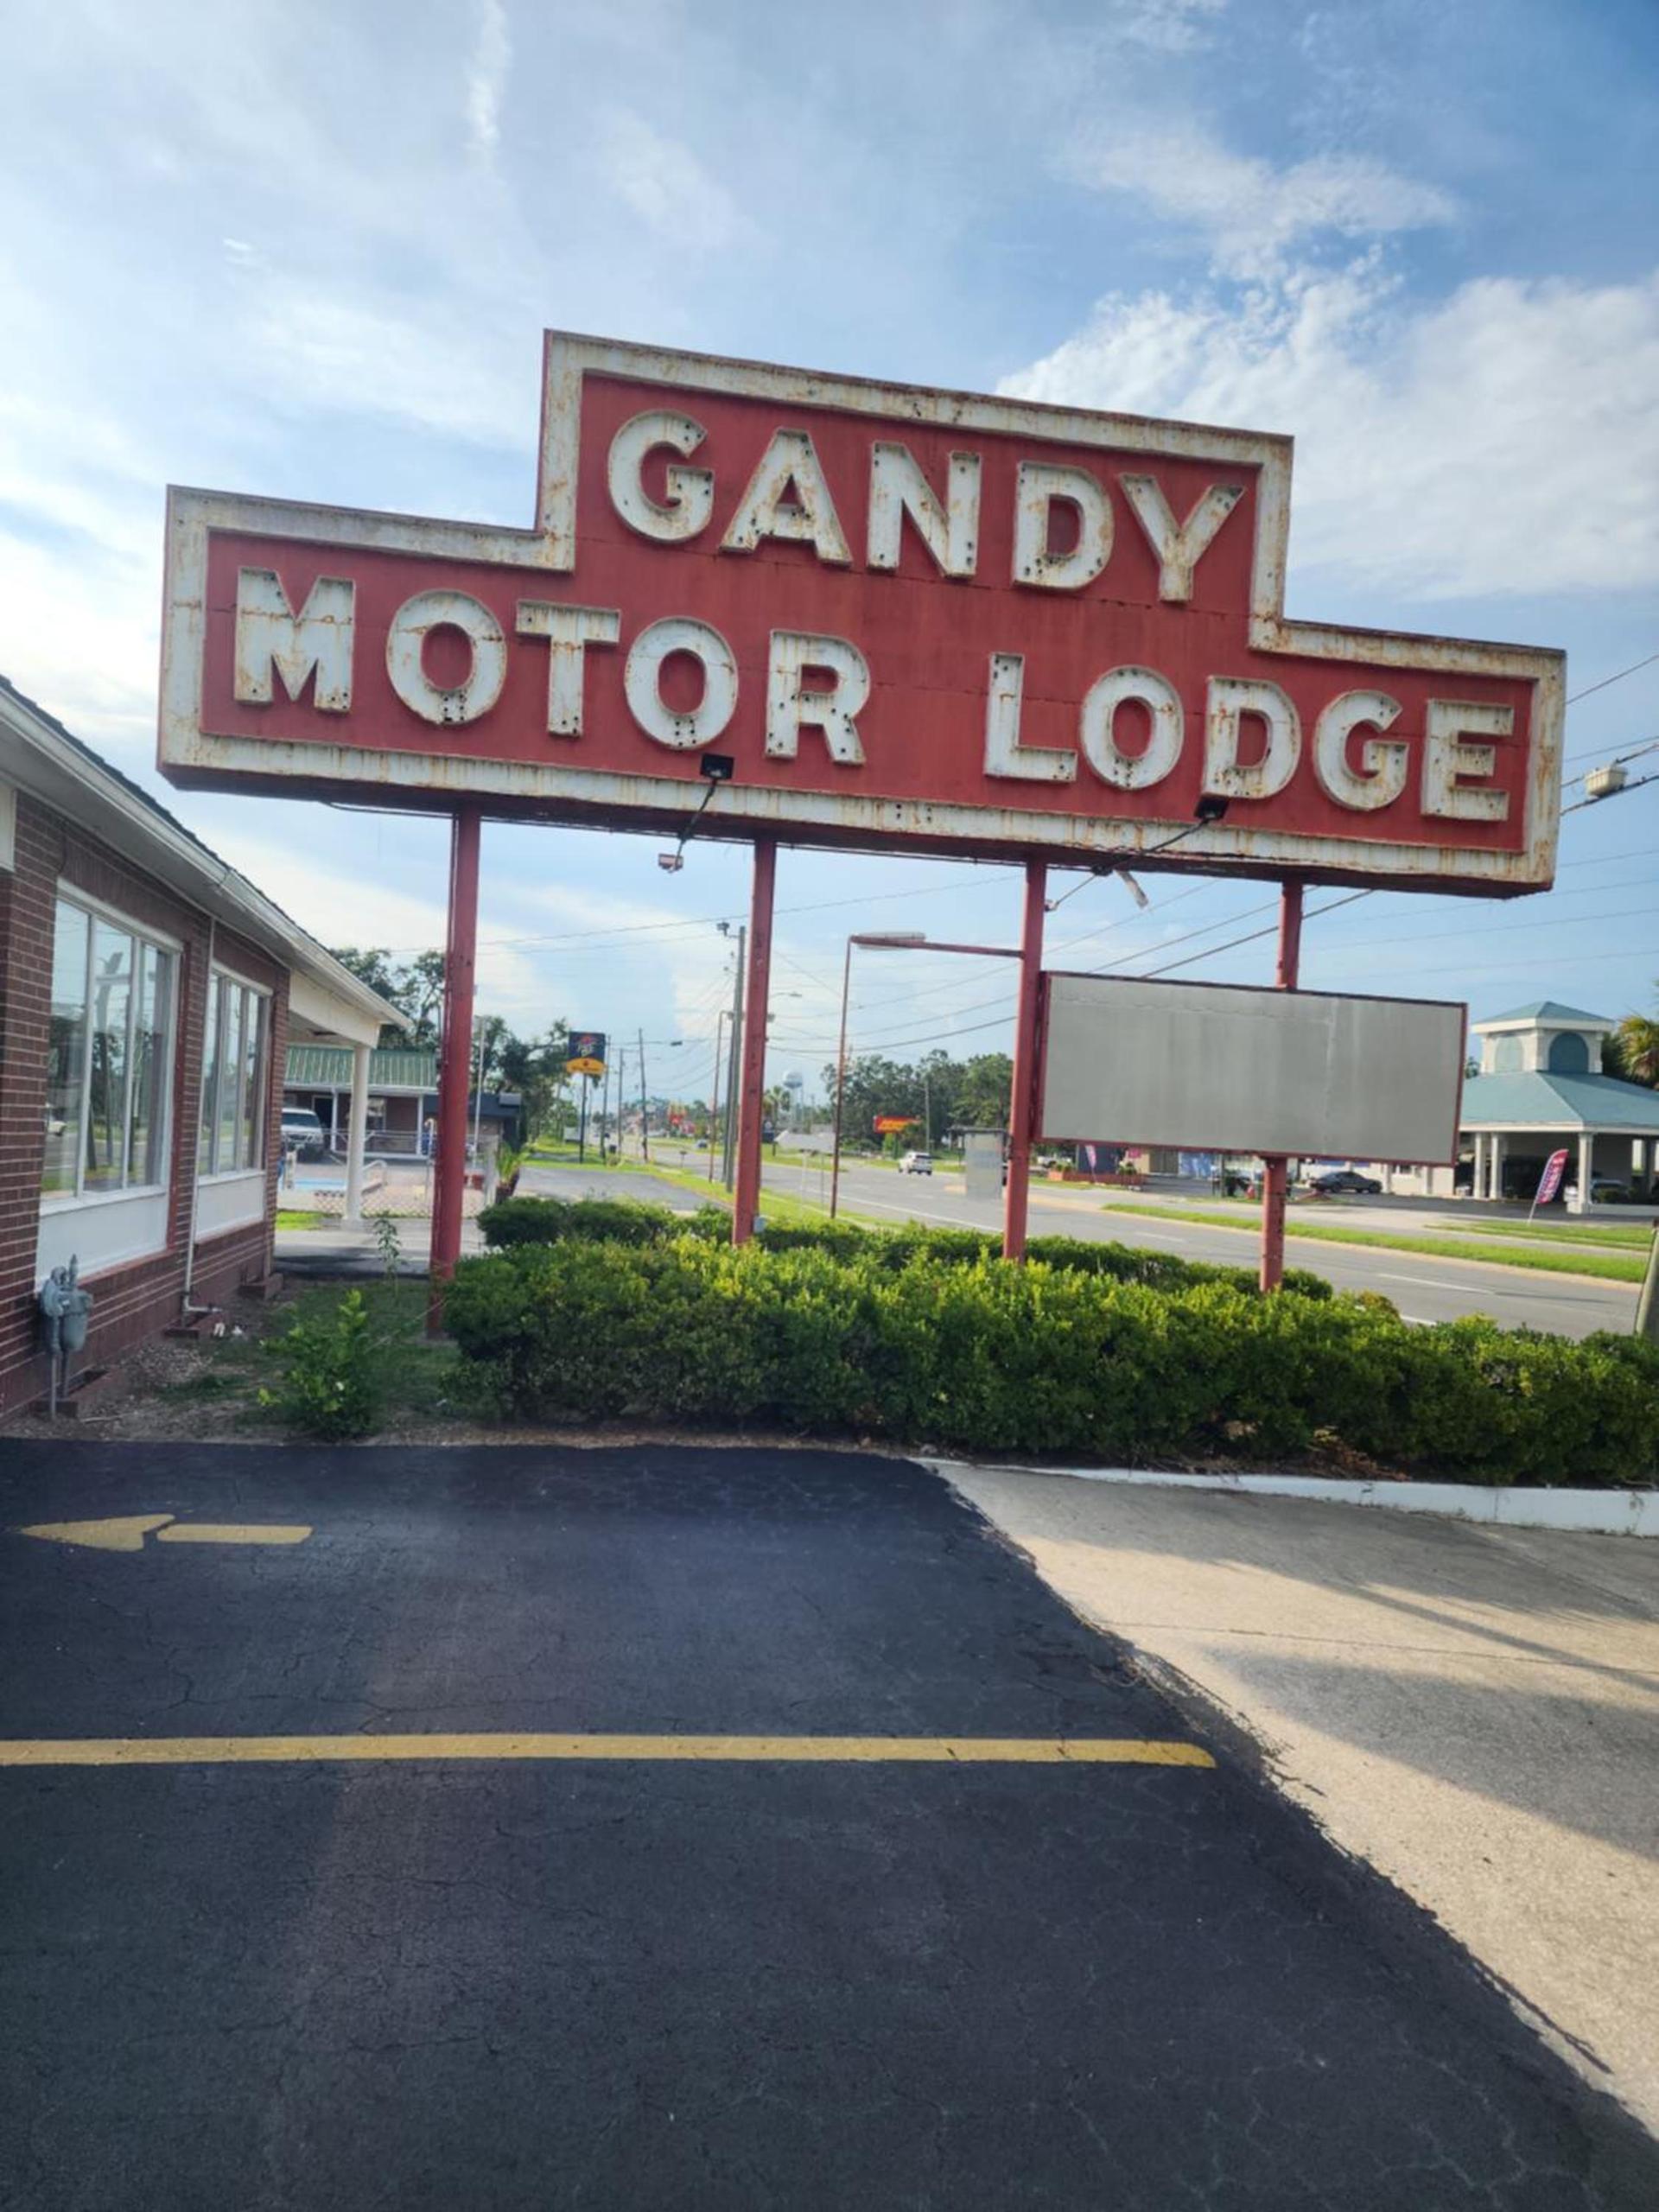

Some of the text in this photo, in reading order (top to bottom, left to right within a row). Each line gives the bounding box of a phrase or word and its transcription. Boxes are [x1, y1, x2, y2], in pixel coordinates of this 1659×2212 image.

[607, 409, 1246, 603] GANDY
[233, 566, 1516, 821] MOTOR LODGE
